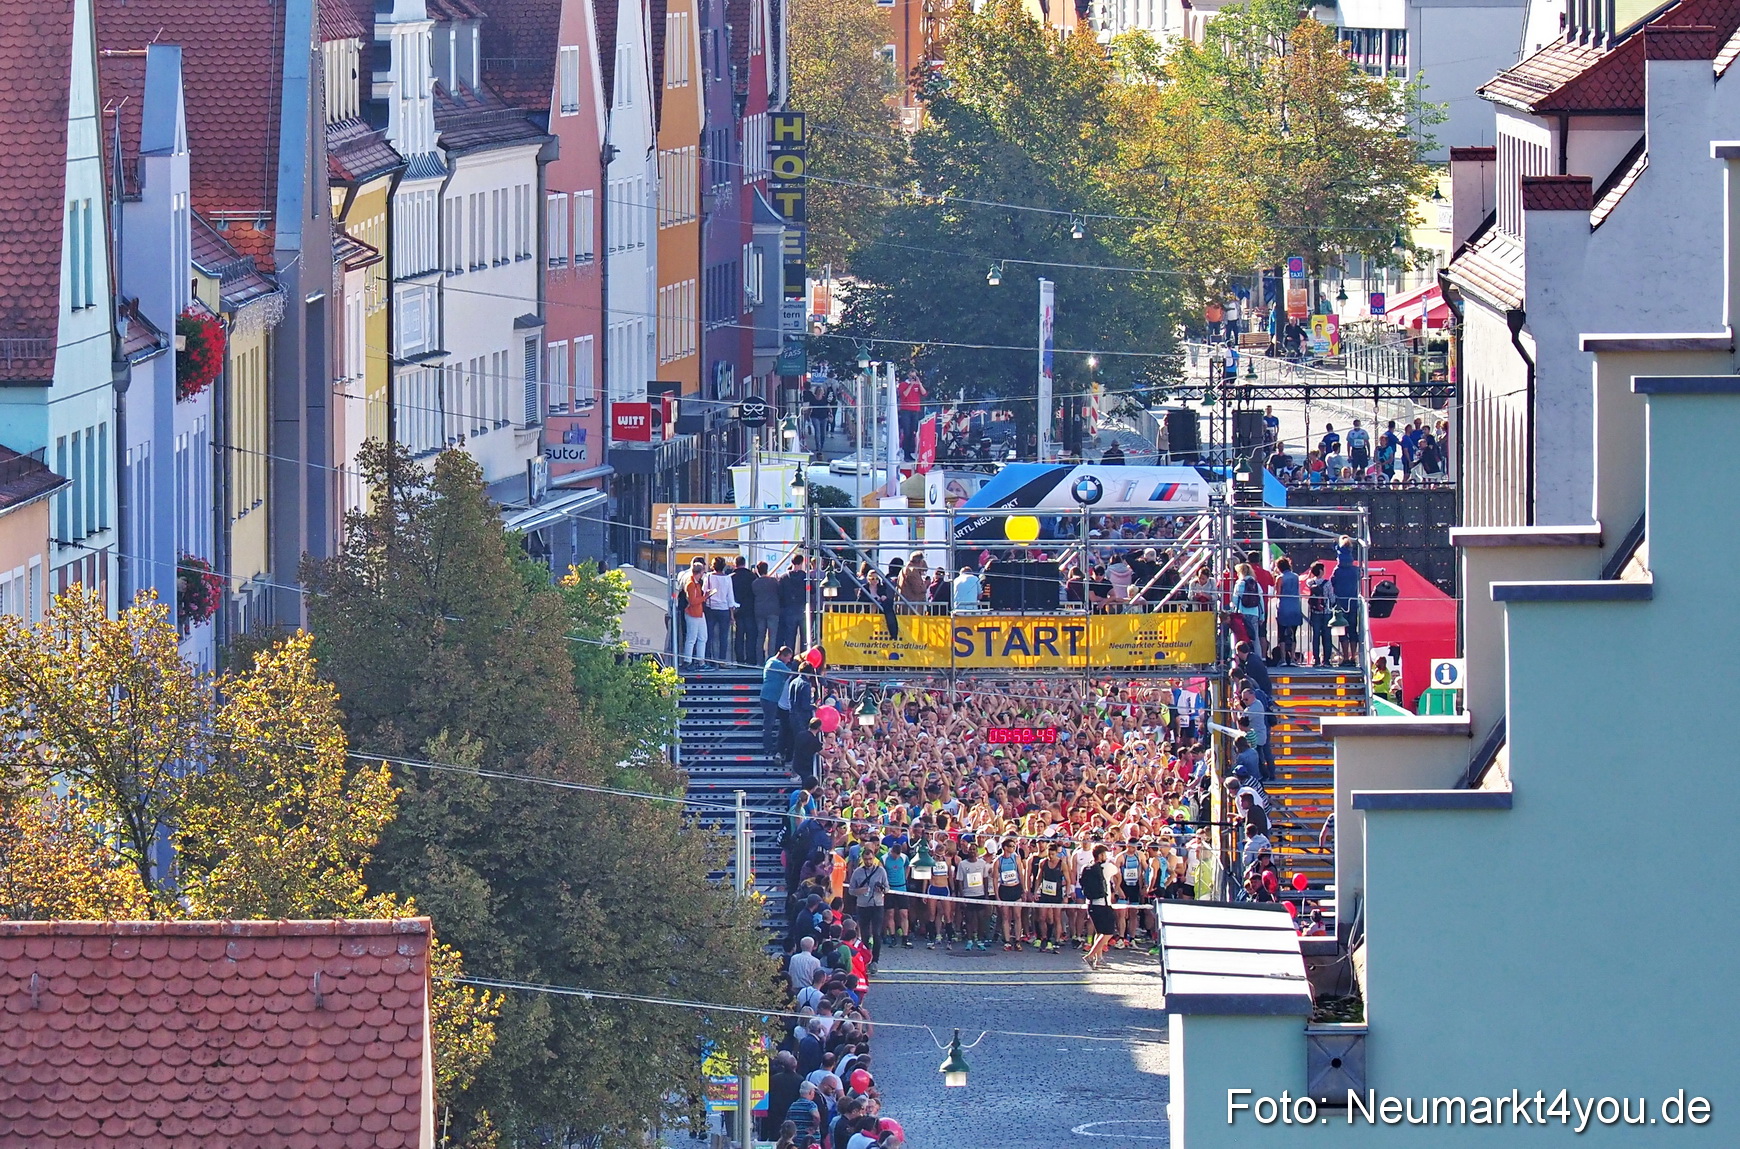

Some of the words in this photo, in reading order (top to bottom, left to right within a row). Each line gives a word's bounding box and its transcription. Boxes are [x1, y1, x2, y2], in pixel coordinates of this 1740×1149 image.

[773, 117, 804, 292] HOTE
[617, 415, 645, 426] WITT
[953, 525, 975, 539] ARTL
[973, 497, 1019, 528] NEURKT
[843, 640, 890, 649] Neumarkter
[892, 641, 929, 651] Stadtlauf
[954, 626, 1084, 657] START
[1108, 642, 1155, 650] Neumarkter
[1157, 639, 1193, 649] Stadtlauf
